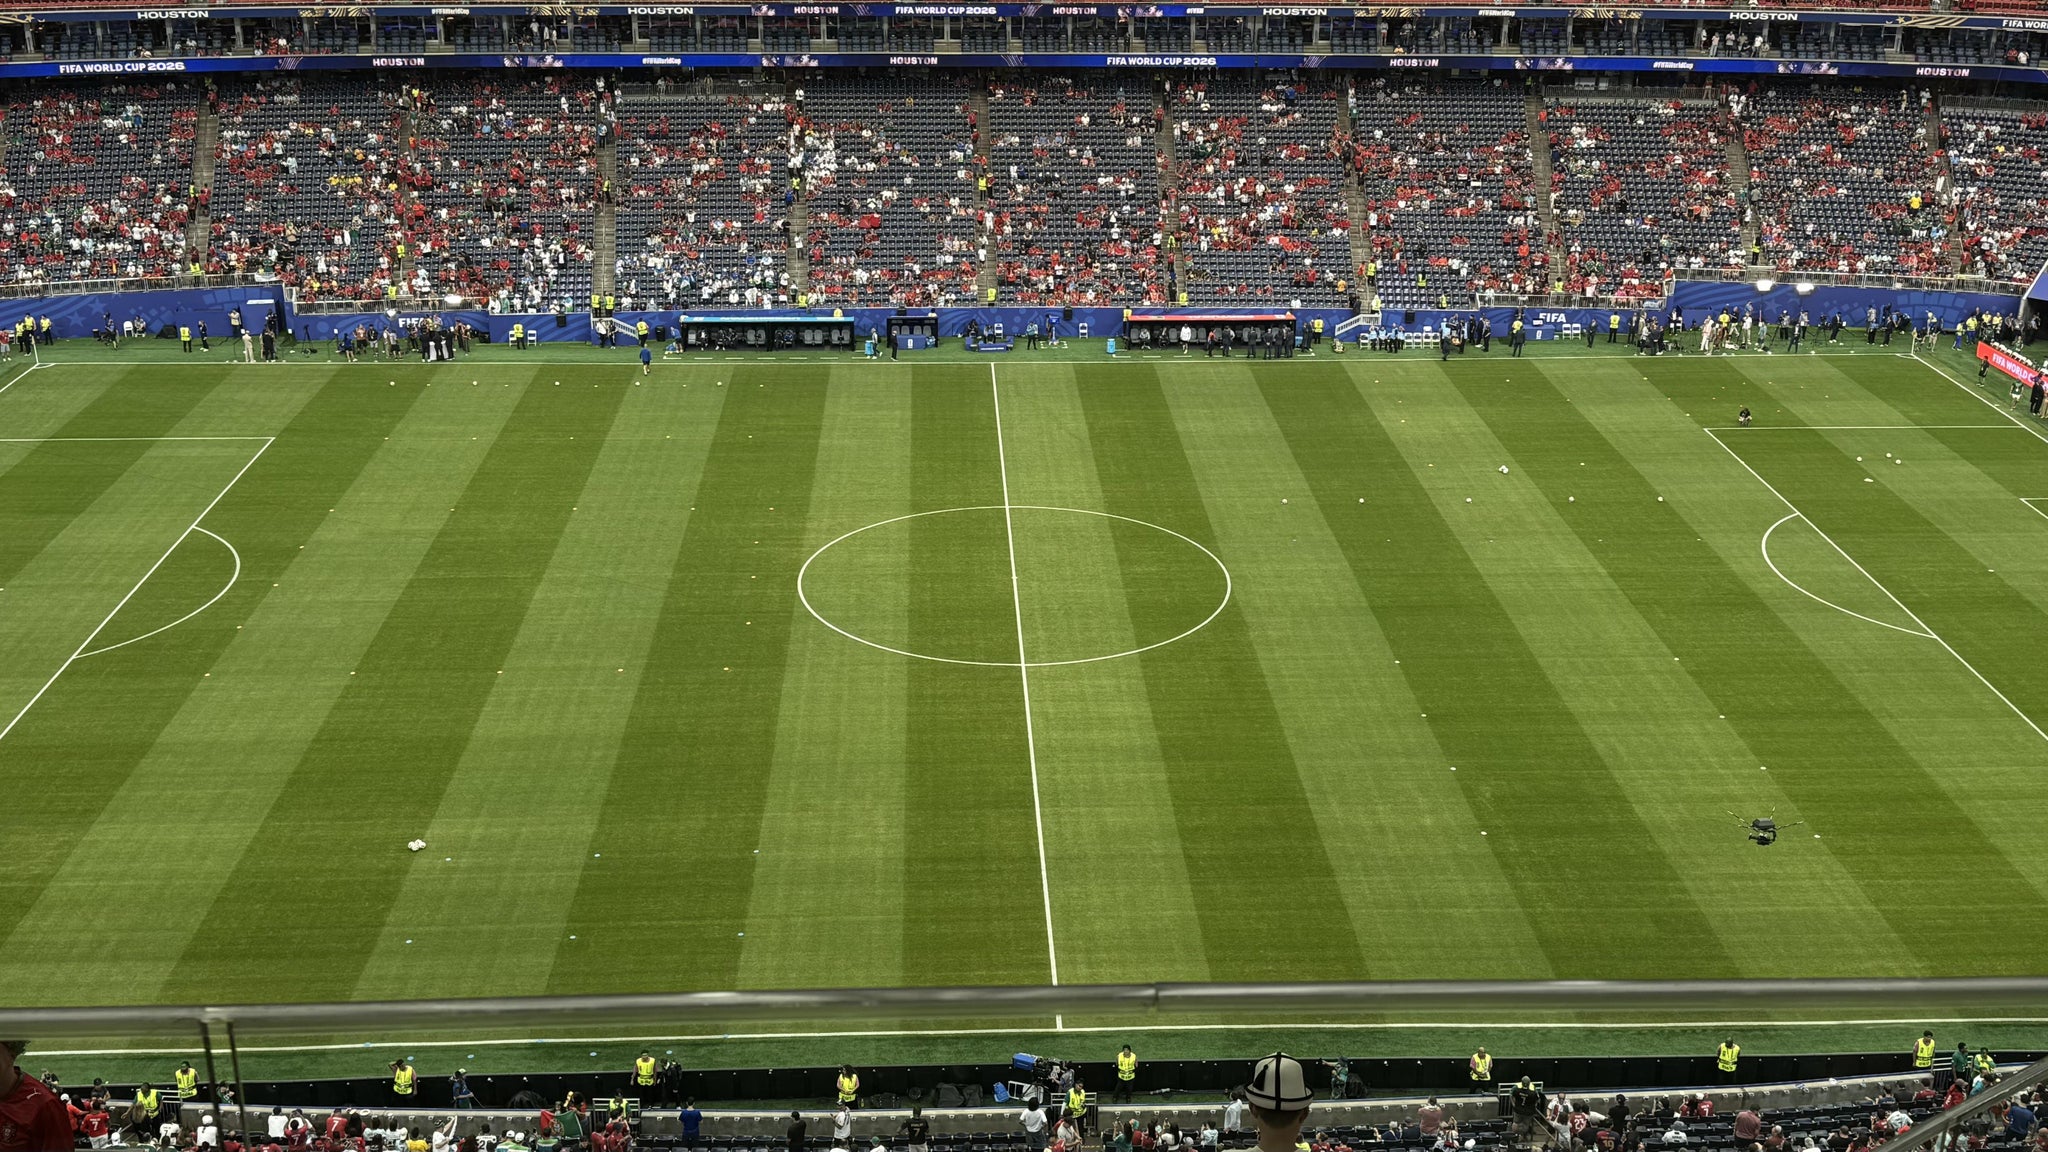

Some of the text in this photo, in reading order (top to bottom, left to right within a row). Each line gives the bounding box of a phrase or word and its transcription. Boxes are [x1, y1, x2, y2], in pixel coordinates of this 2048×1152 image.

[137, 10, 209, 19] HOUSTON
[627, 7, 694, 15] HOUSTON
[794, 6, 839, 14] HOUSTON
[895, 6, 997, 14] FIFA WORLD CUP 2026
[1052, 7, 1097, 15] HOUSTON
[1262, 8, 1327, 16] HOUSTON
[1729, 12, 1799, 21] HOUSTON
[2002, 19, 2024, 28] FIFA
[372, 57, 425, 67] HOUSTON
[890, 56, 938, 65] HOUSTON
[1106, 57, 1217, 65] FIFA WORLD CUP 2026
[1389, 58, 1439, 67] HOUSTON
[59, 61, 185, 74] FIFA WORLD CUP 2026
[1916, 67, 1970, 77] HOUSTON
[1539, 312, 1567, 323] FIFA
[1992, 353, 2028, 379] FIFA WORLD
[1703, 1108, 1709, 1117] 7
[92, 1121, 99, 1131] 7
[331, 1120, 339, 1132] 7
[913, 1128, 920, 1137] 7
[293, 1137, 299, 1146] 7
